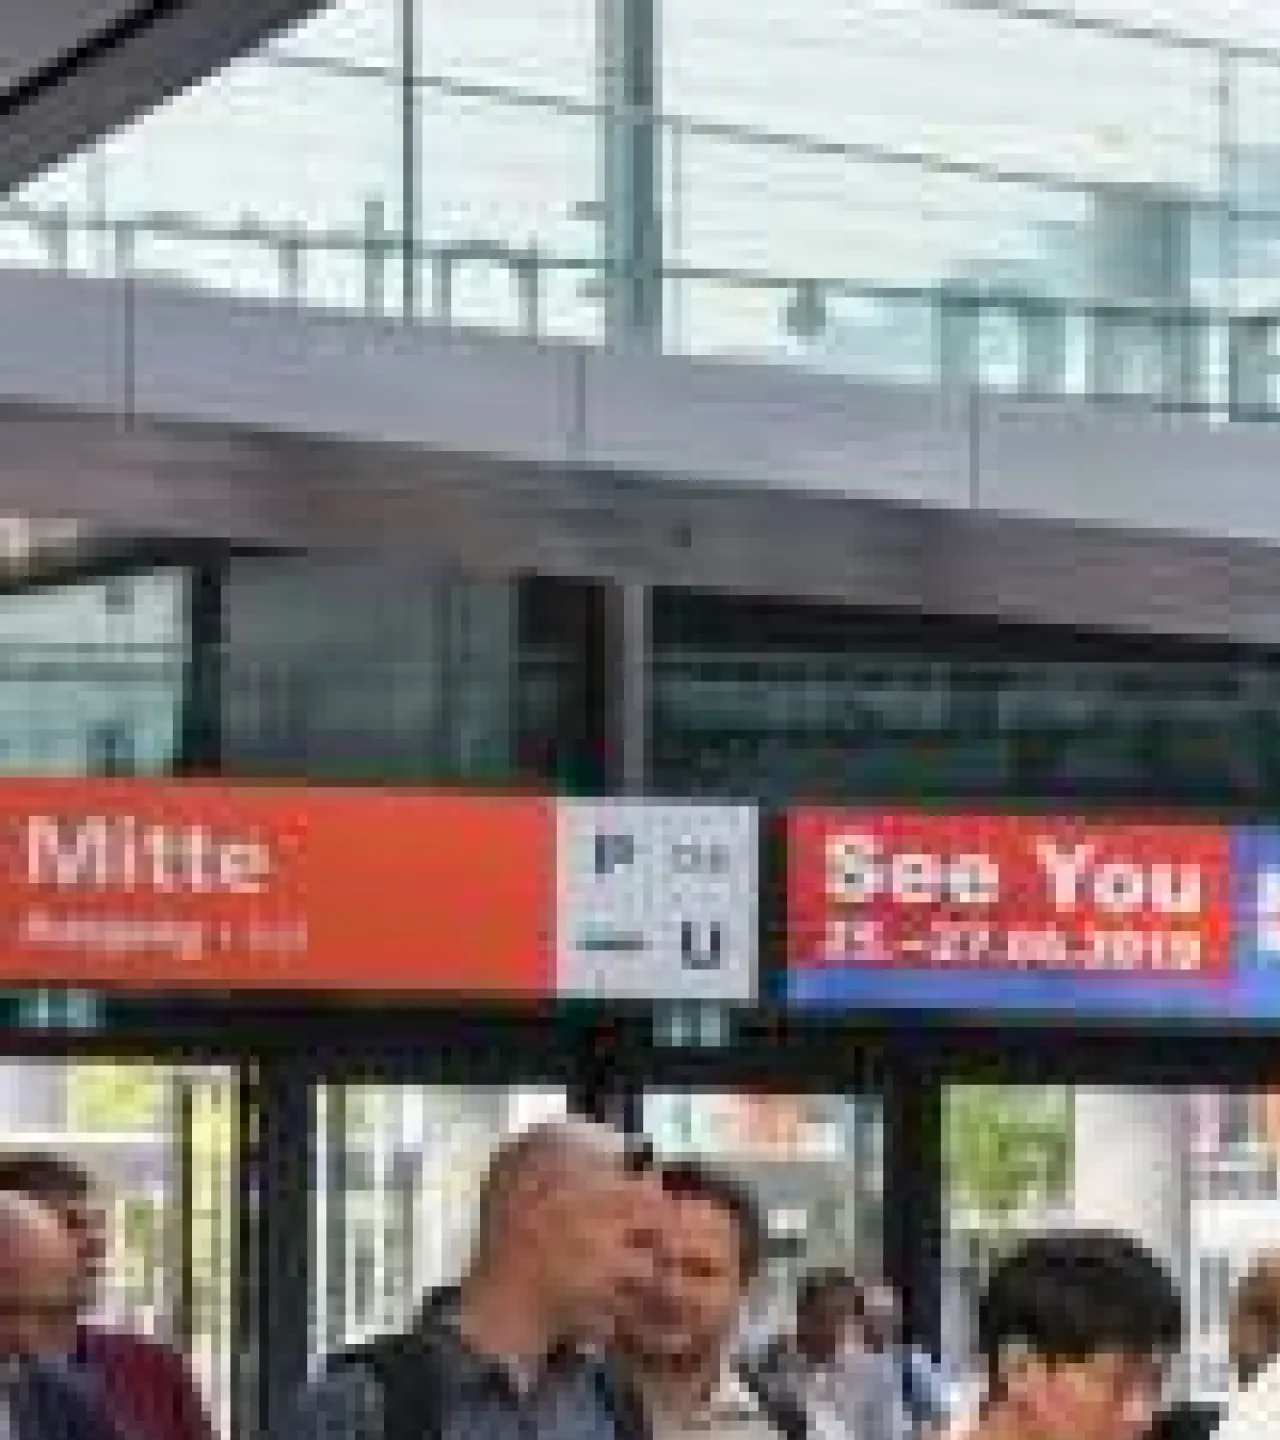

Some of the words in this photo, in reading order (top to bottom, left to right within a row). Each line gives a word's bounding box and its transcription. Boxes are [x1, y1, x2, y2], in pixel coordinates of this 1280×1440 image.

[26, 813, 271, 895] Mitte
[823, 833, 1000, 905] See
[1036, 835, 1203, 914] You
